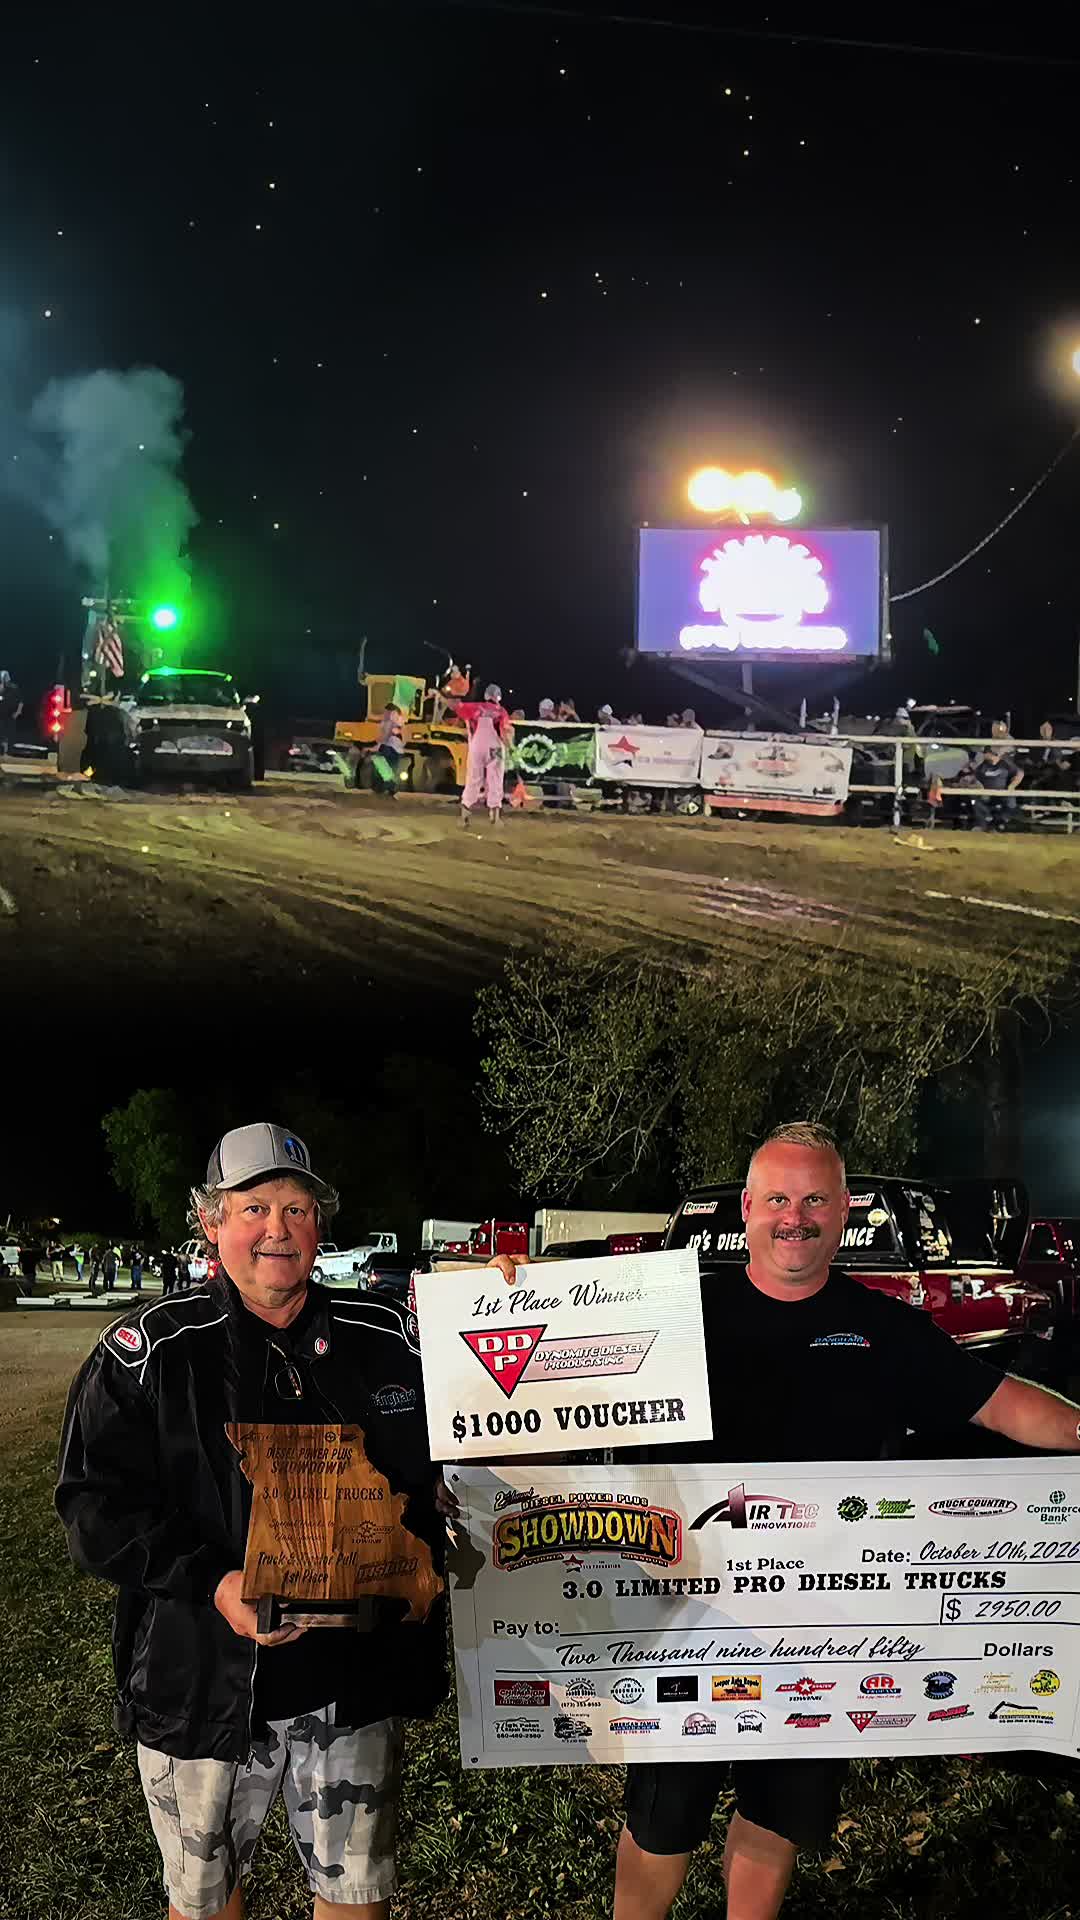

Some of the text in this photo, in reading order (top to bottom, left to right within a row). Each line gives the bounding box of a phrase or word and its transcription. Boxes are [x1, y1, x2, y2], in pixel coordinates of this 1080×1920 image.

[686, 1229, 711, 1251] JD'S
[717, 1233, 749, 1250] DIES
[472, 1294, 502, 1317] 1st
[509, 1289, 562, 1315] Place
[117, 1329, 138, 1347] BELL
[534, 1344, 643, 1362] DYNOMITE DIESEL
[544, 1356, 624, 1371] PRODUCTS INC
[452, 1398, 686, 1443] $1000 VOUCHER
[266, 1448, 353, 1460] DIESEL POWER PLUS
[336, 1487, 384, 1501] TRUCKS
[522, 1493, 649, 1511] DIESEL POWER PLUS
[933, 1499, 1012, 1509] TRUCK COUNTRY
[751, 1522, 817, 1530] INNOVATIONS
[1040, 1513, 1067, 1522] Bank
[499, 1509, 678, 1558] SHOWDOWN
[257, 1551, 286, 1566] Truck
[336, 1551, 358, 1566] Pull
[862, 1549, 911, 1563] Date:
[919, 1541, 981, 1561] October
[726, 1557, 805, 1571] 1st Place
[302, 1569, 329, 1584] Place
[562, 1571, 1008, 1599] 3.0 LIMITED PRO DIESEL TRUCKS
[945, 1598, 1062, 1622] $ 2950.00
[493, 1619, 560, 1638] Pay to:
[555, 1635, 1054, 1667] Two Thousand nine hundred fifty Dollars
